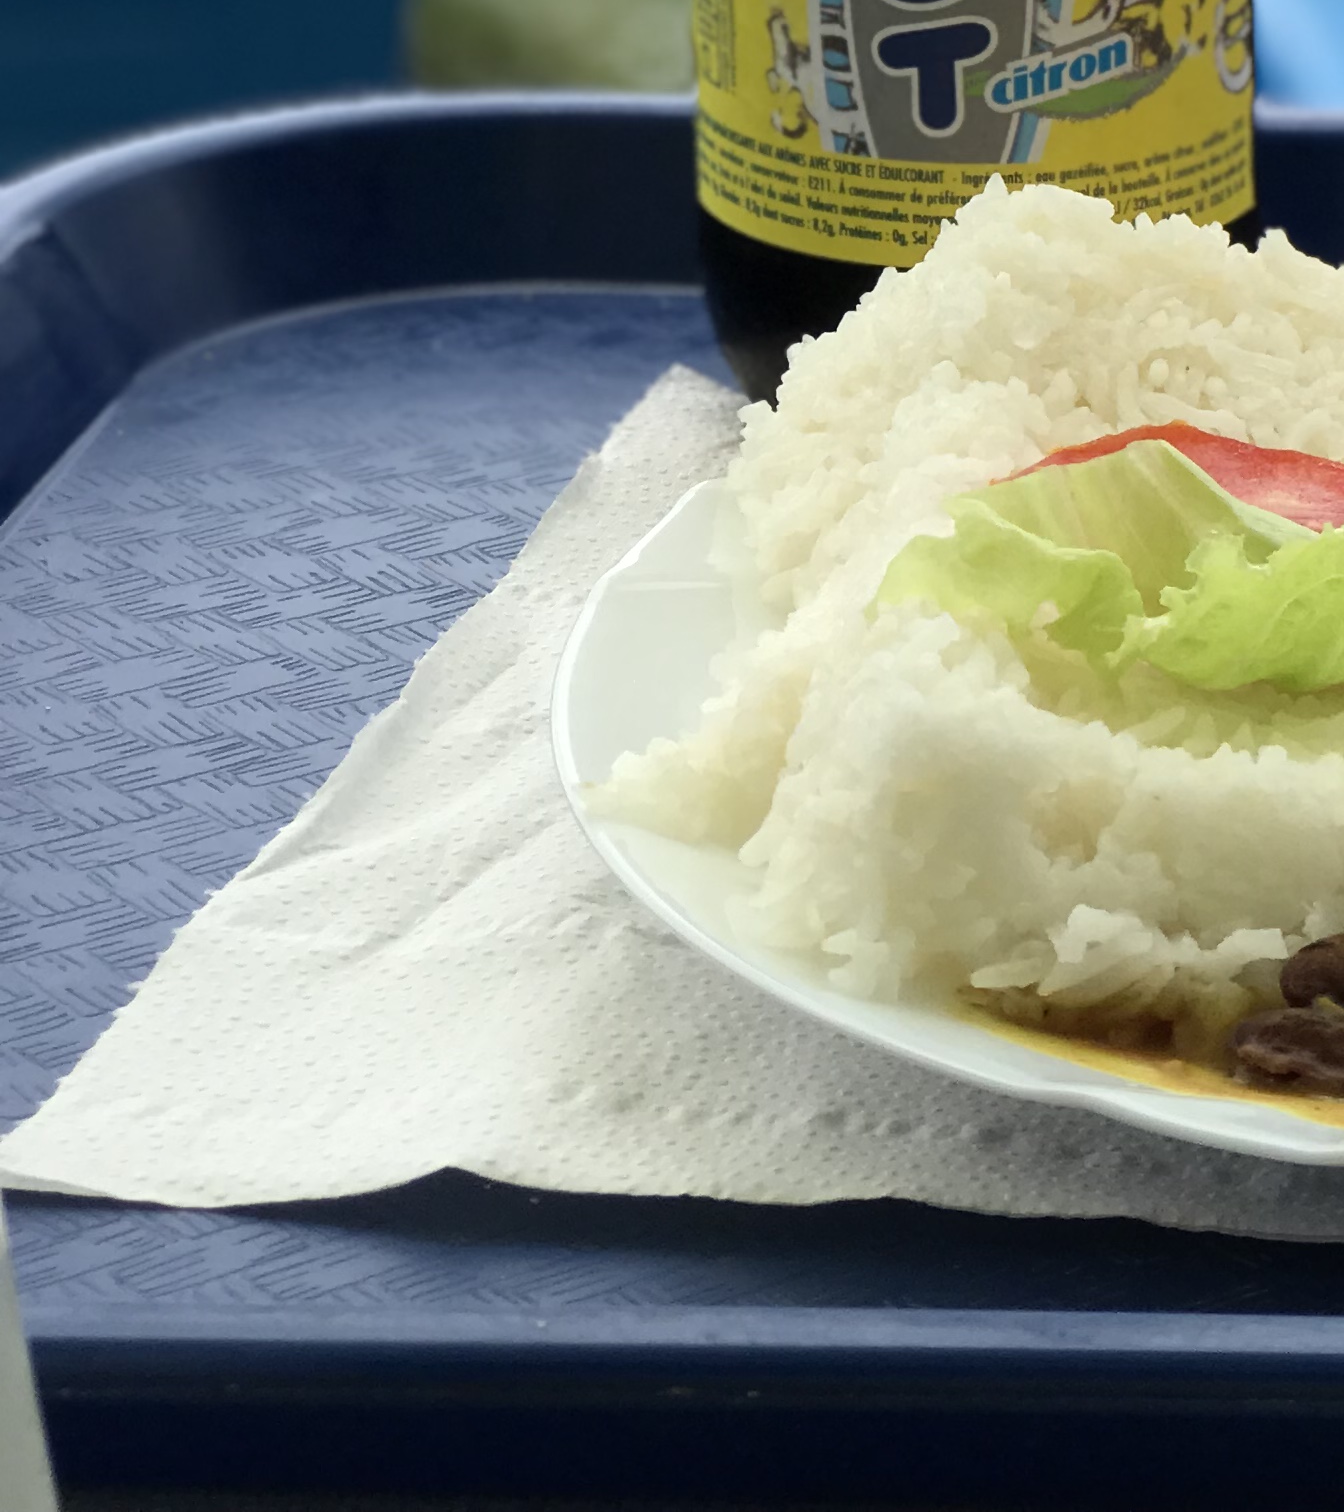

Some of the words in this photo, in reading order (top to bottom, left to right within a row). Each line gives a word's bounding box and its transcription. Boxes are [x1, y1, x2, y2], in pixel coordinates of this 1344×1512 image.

[988, 35, 1130, 108] citron
[809, 155, 831, 171] AVEC
[833, 159, 862, 177] SUCRE
[865, 164, 877, 178] ET
[879, 162, 944, 184] ÉDULCORANT
[1035, 172, 1056, 183] eau
[849, 186, 906, 203] consommer
[910, 188, 923, 204] de
